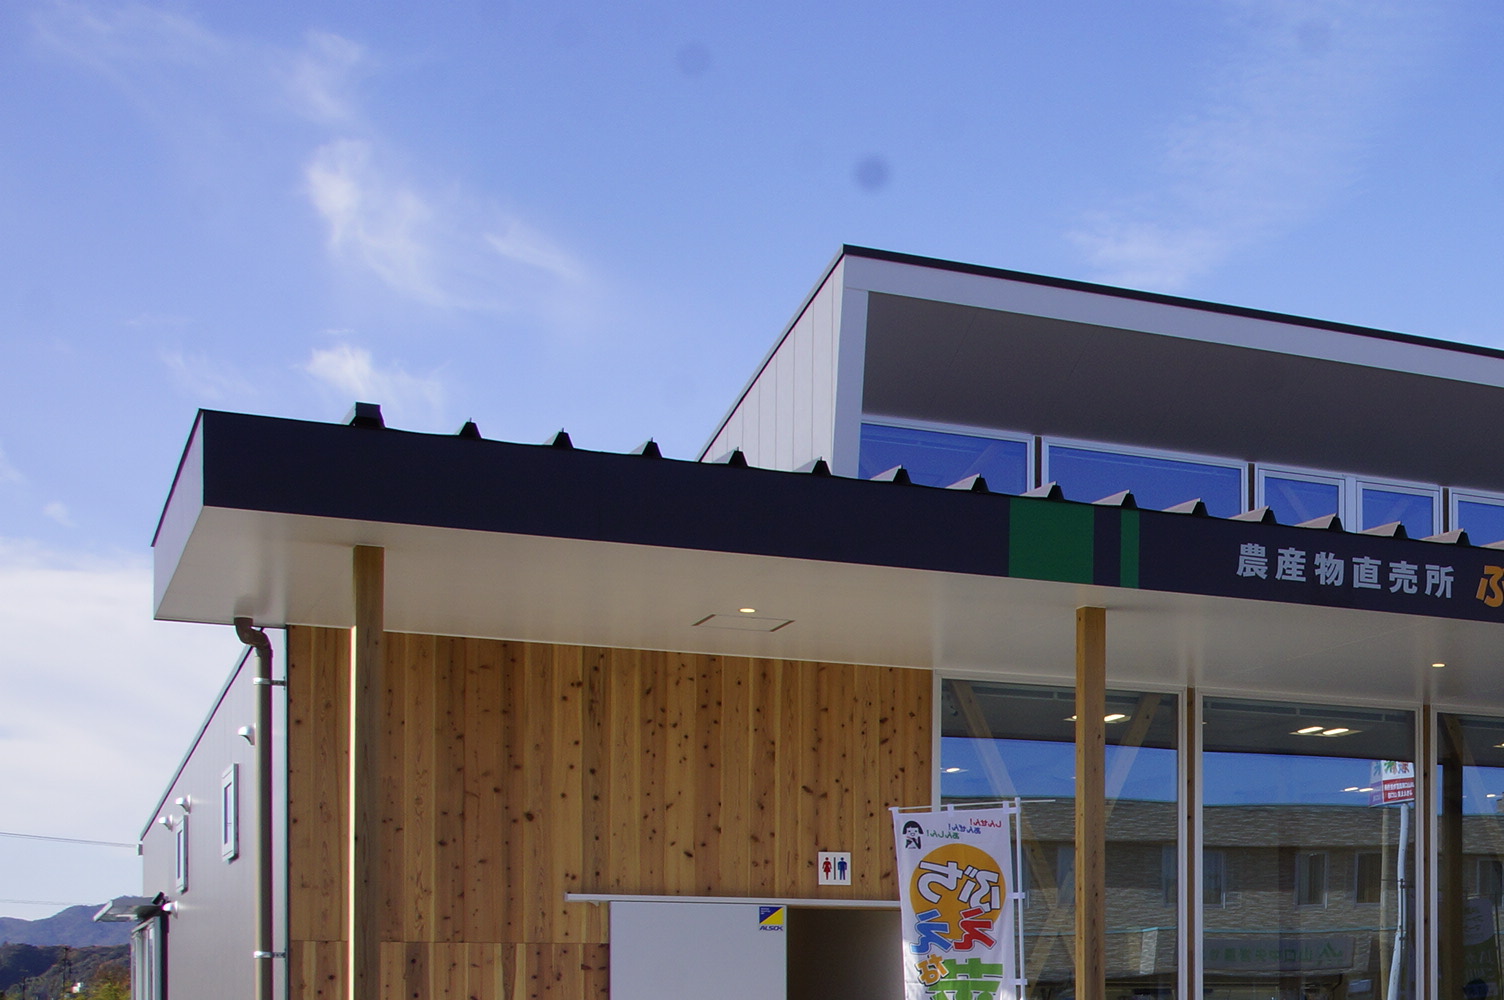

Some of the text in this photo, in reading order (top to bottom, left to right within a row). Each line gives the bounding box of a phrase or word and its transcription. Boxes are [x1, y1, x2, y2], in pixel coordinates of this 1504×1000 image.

[1236, 543, 1455, 599] 農産物直売所
